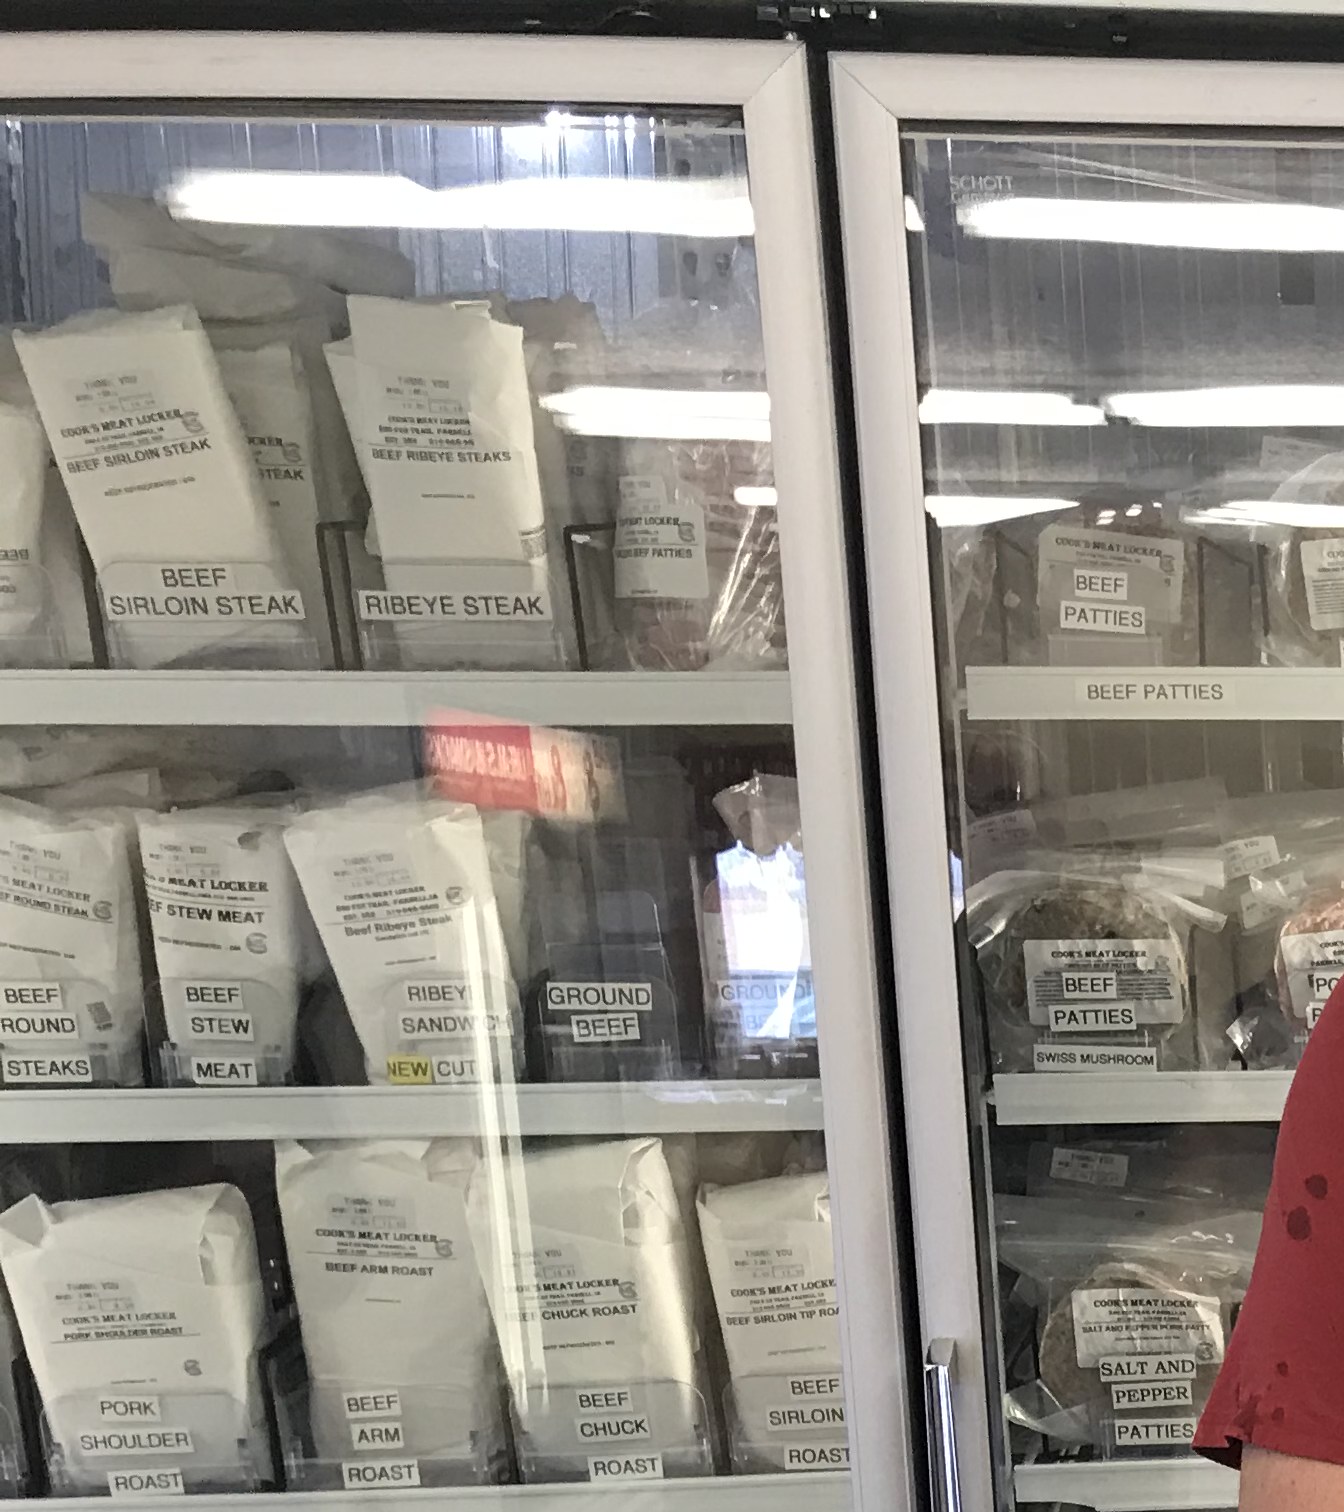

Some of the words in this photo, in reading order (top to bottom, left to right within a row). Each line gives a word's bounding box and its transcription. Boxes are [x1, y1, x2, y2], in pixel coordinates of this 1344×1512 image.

[161, 568, 226, 588] BEEF
[1076, 575, 1125, 594] BEEF
[110, 596, 211, 617] SIRLOIN
[215, 594, 300, 616] STEAK
[366, 595, 455, 616] RIBEYE
[463, 596, 544, 616] STEAK
[1064, 606, 1143, 628] PATTIES
[1087, 684, 1136, 700] BEEF
[1144, 684, 1224, 700] PATTIES
[210, 880, 268, 892] LOCKER
[166, 905, 214, 923] STEW
[218, 908, 264, 924] MEAT
[418, 914, 453, 928] Steak
[1051, 950, 1084, 959] COOK'S
[1086, 950, 1110, 958] MEAT
[1112, 950, 1147, 958] LOCKER
[1064, 978, 1114, 992] BEEF
[4, 988, 58, 1004] BEEF
[186, 986, 240, 1003] BEEF
[548, 987, 650, 1006] GROUND
[1, 1016, 76, 1034] ROUND
[191, 1016, 250, 1034] STEW
[1054, 1009, 1134, 1025] PATTIES
[576, 1018, 638, 1037] BEEF
[1036, 1052, 1077, 1064] SWISS
[1080, 1054, 1154, 1066] MUSHROOM
[7, 1060, 90, 1077] STEAKS
[196, 1063, 252, 1080] MEAT
[388, 1061, 429, 1077] NEW
[438, 1060, 476, 1076] CUT
[326, 1261, 356, 1273] BEEF
[360, 1264, 388, 1275] ARM
[391, 1266, 434, 1277] ROAST
[1101, 1362, 1148, 1376] SALT
[1155, 1359, 1195, 1374] AND
[790, 1379, 839, 1395] BEEF
[346, 1396, 398, 1413] BEEF
[578, 1391, 628, 1409] BEEF
[1115, 1388, 1188, 1404] PEPPER
[100, 1400, 155, 1416] PORK
[769, 1408, 844, 1426] SIRLOIN
[358, 1428, 400, 1443] ARM
[580, 1419, 648, 1438] CHUCK
[1118, 1422, 1194, 1440] PATTIES
[80, 1433, 190, 1451] SHOULDER
[788, 1448, 850, 1464] ROAST
[348, 1464, 415, 1481] ROAST
[594, 1457, 659, 1476] ROAST
[114, 1474, 182, 1491] ROAST
